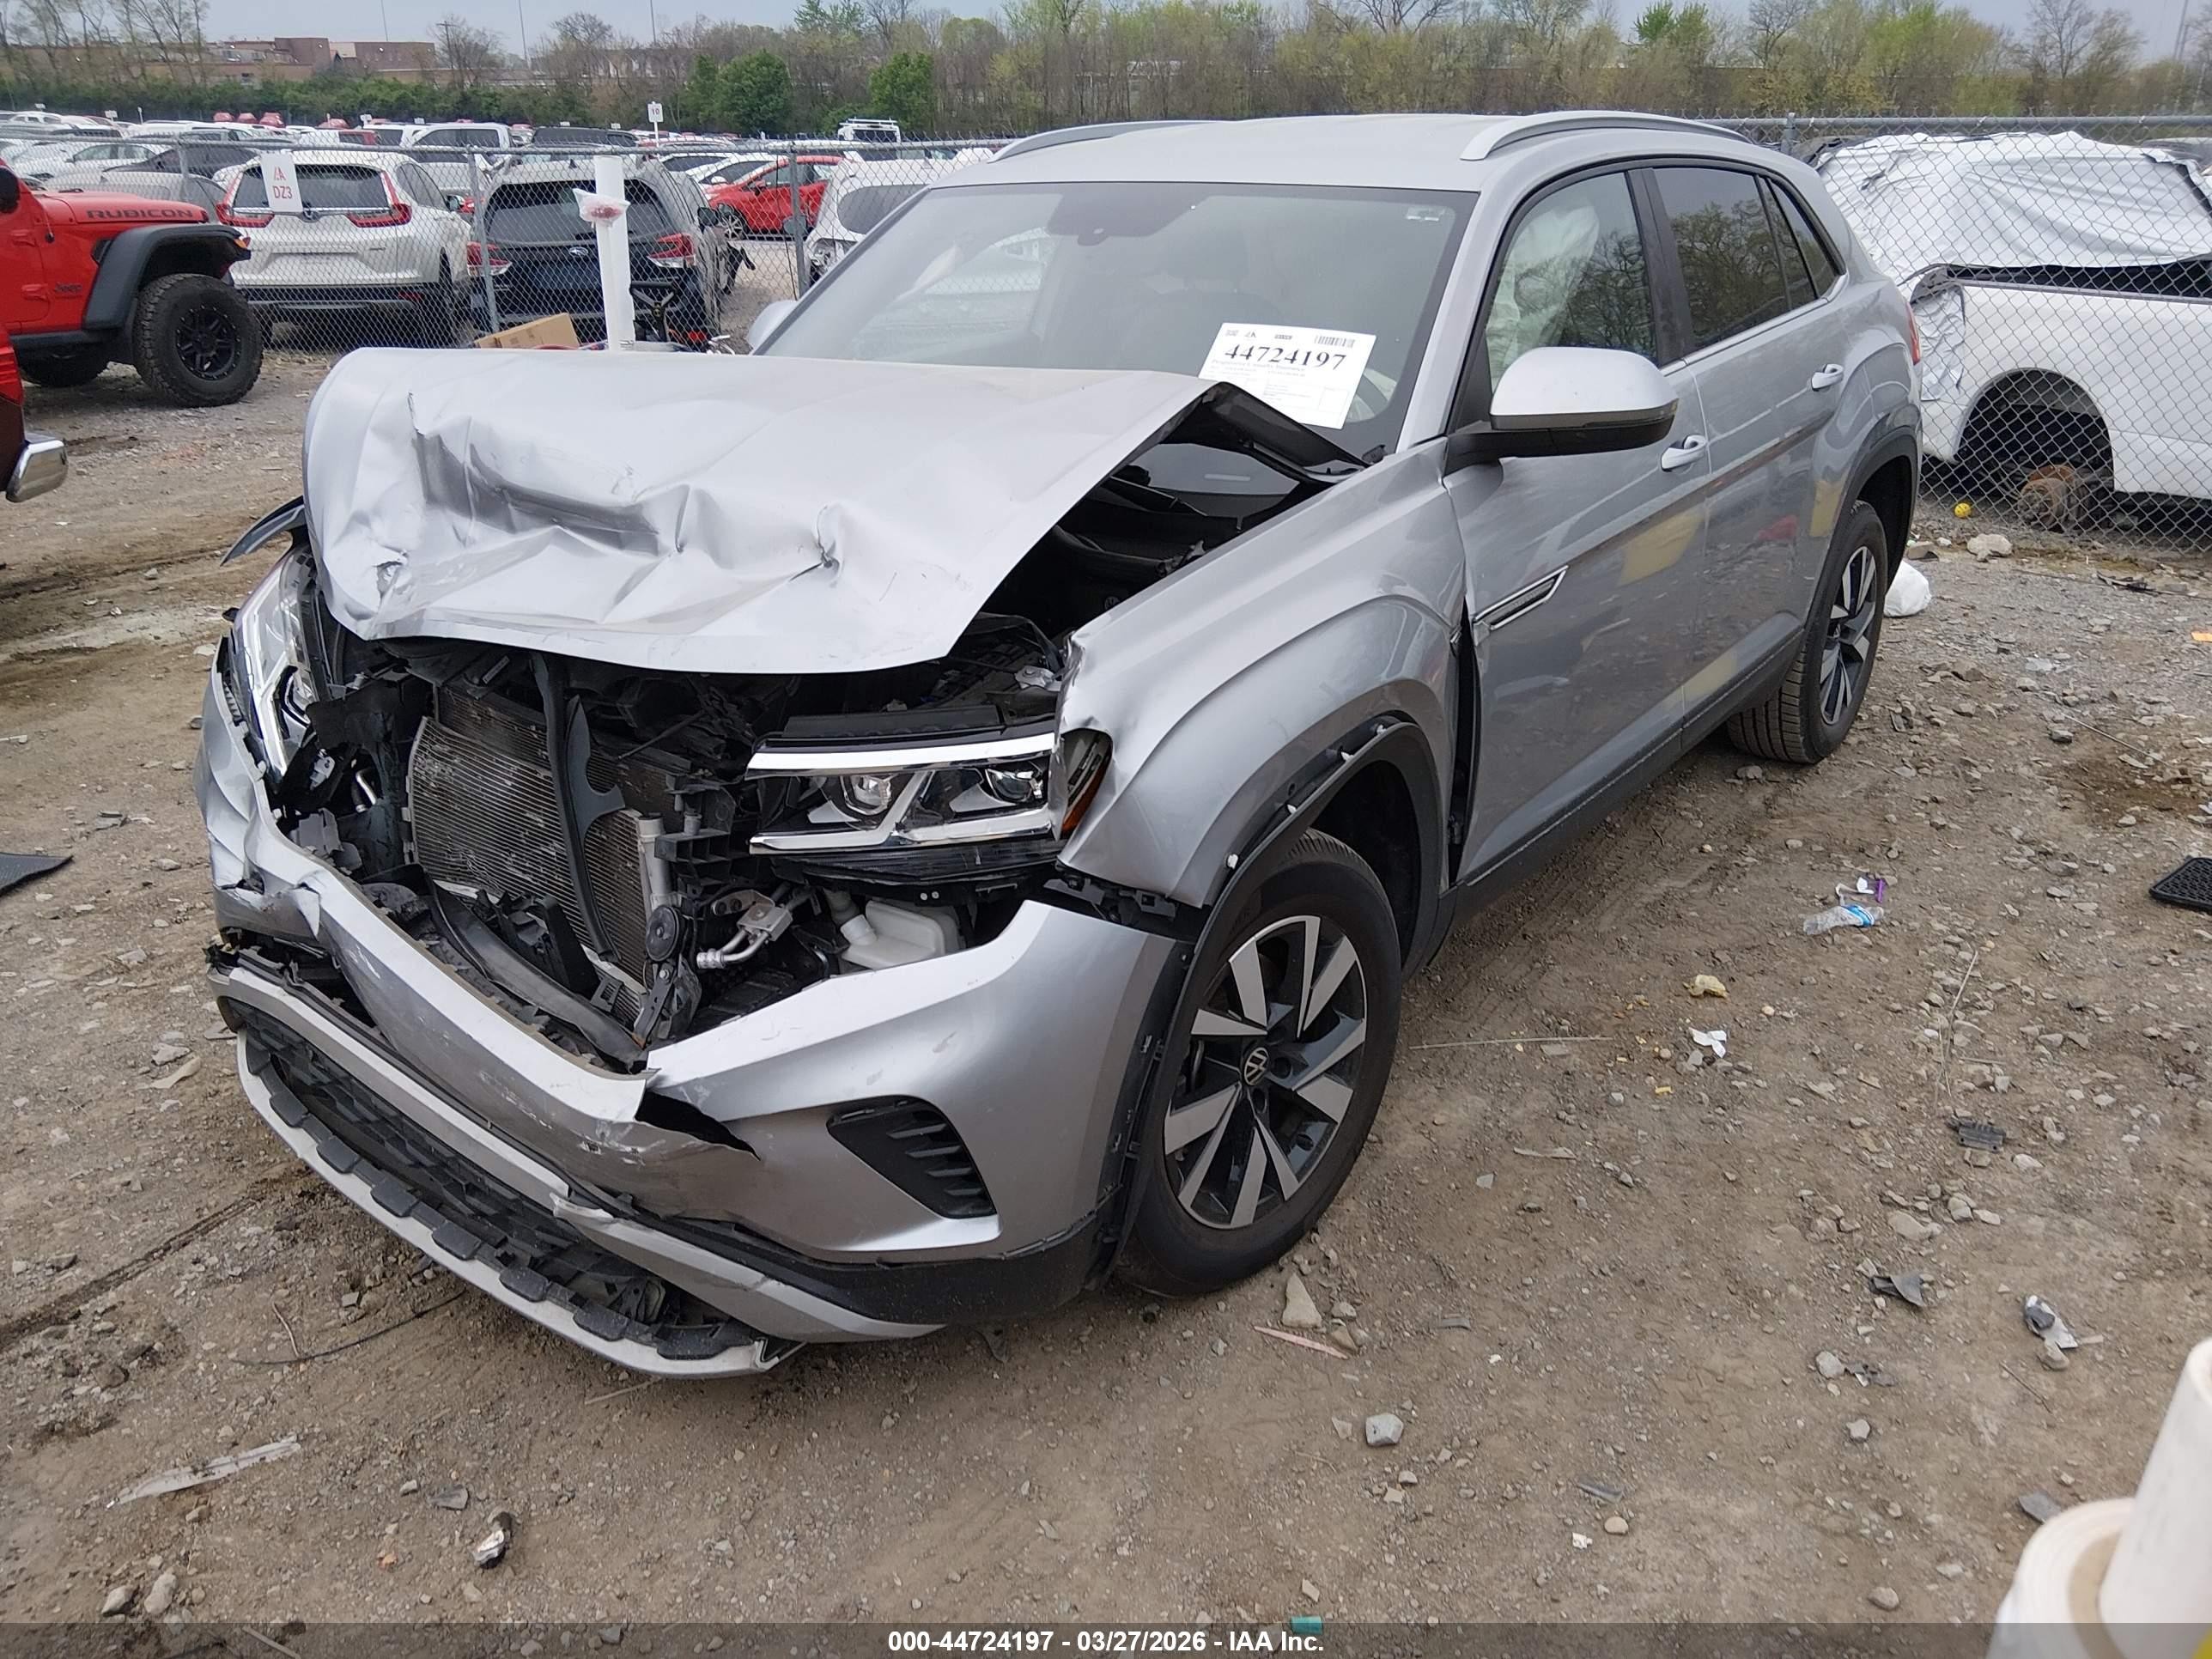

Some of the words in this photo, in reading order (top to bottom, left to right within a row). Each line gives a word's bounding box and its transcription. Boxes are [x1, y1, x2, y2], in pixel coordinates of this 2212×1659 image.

[272, 185, 293, 198] DZ3
[86, 209, 193, 219] RUBICON
[1224, 343, 1346, 370] 44724197
